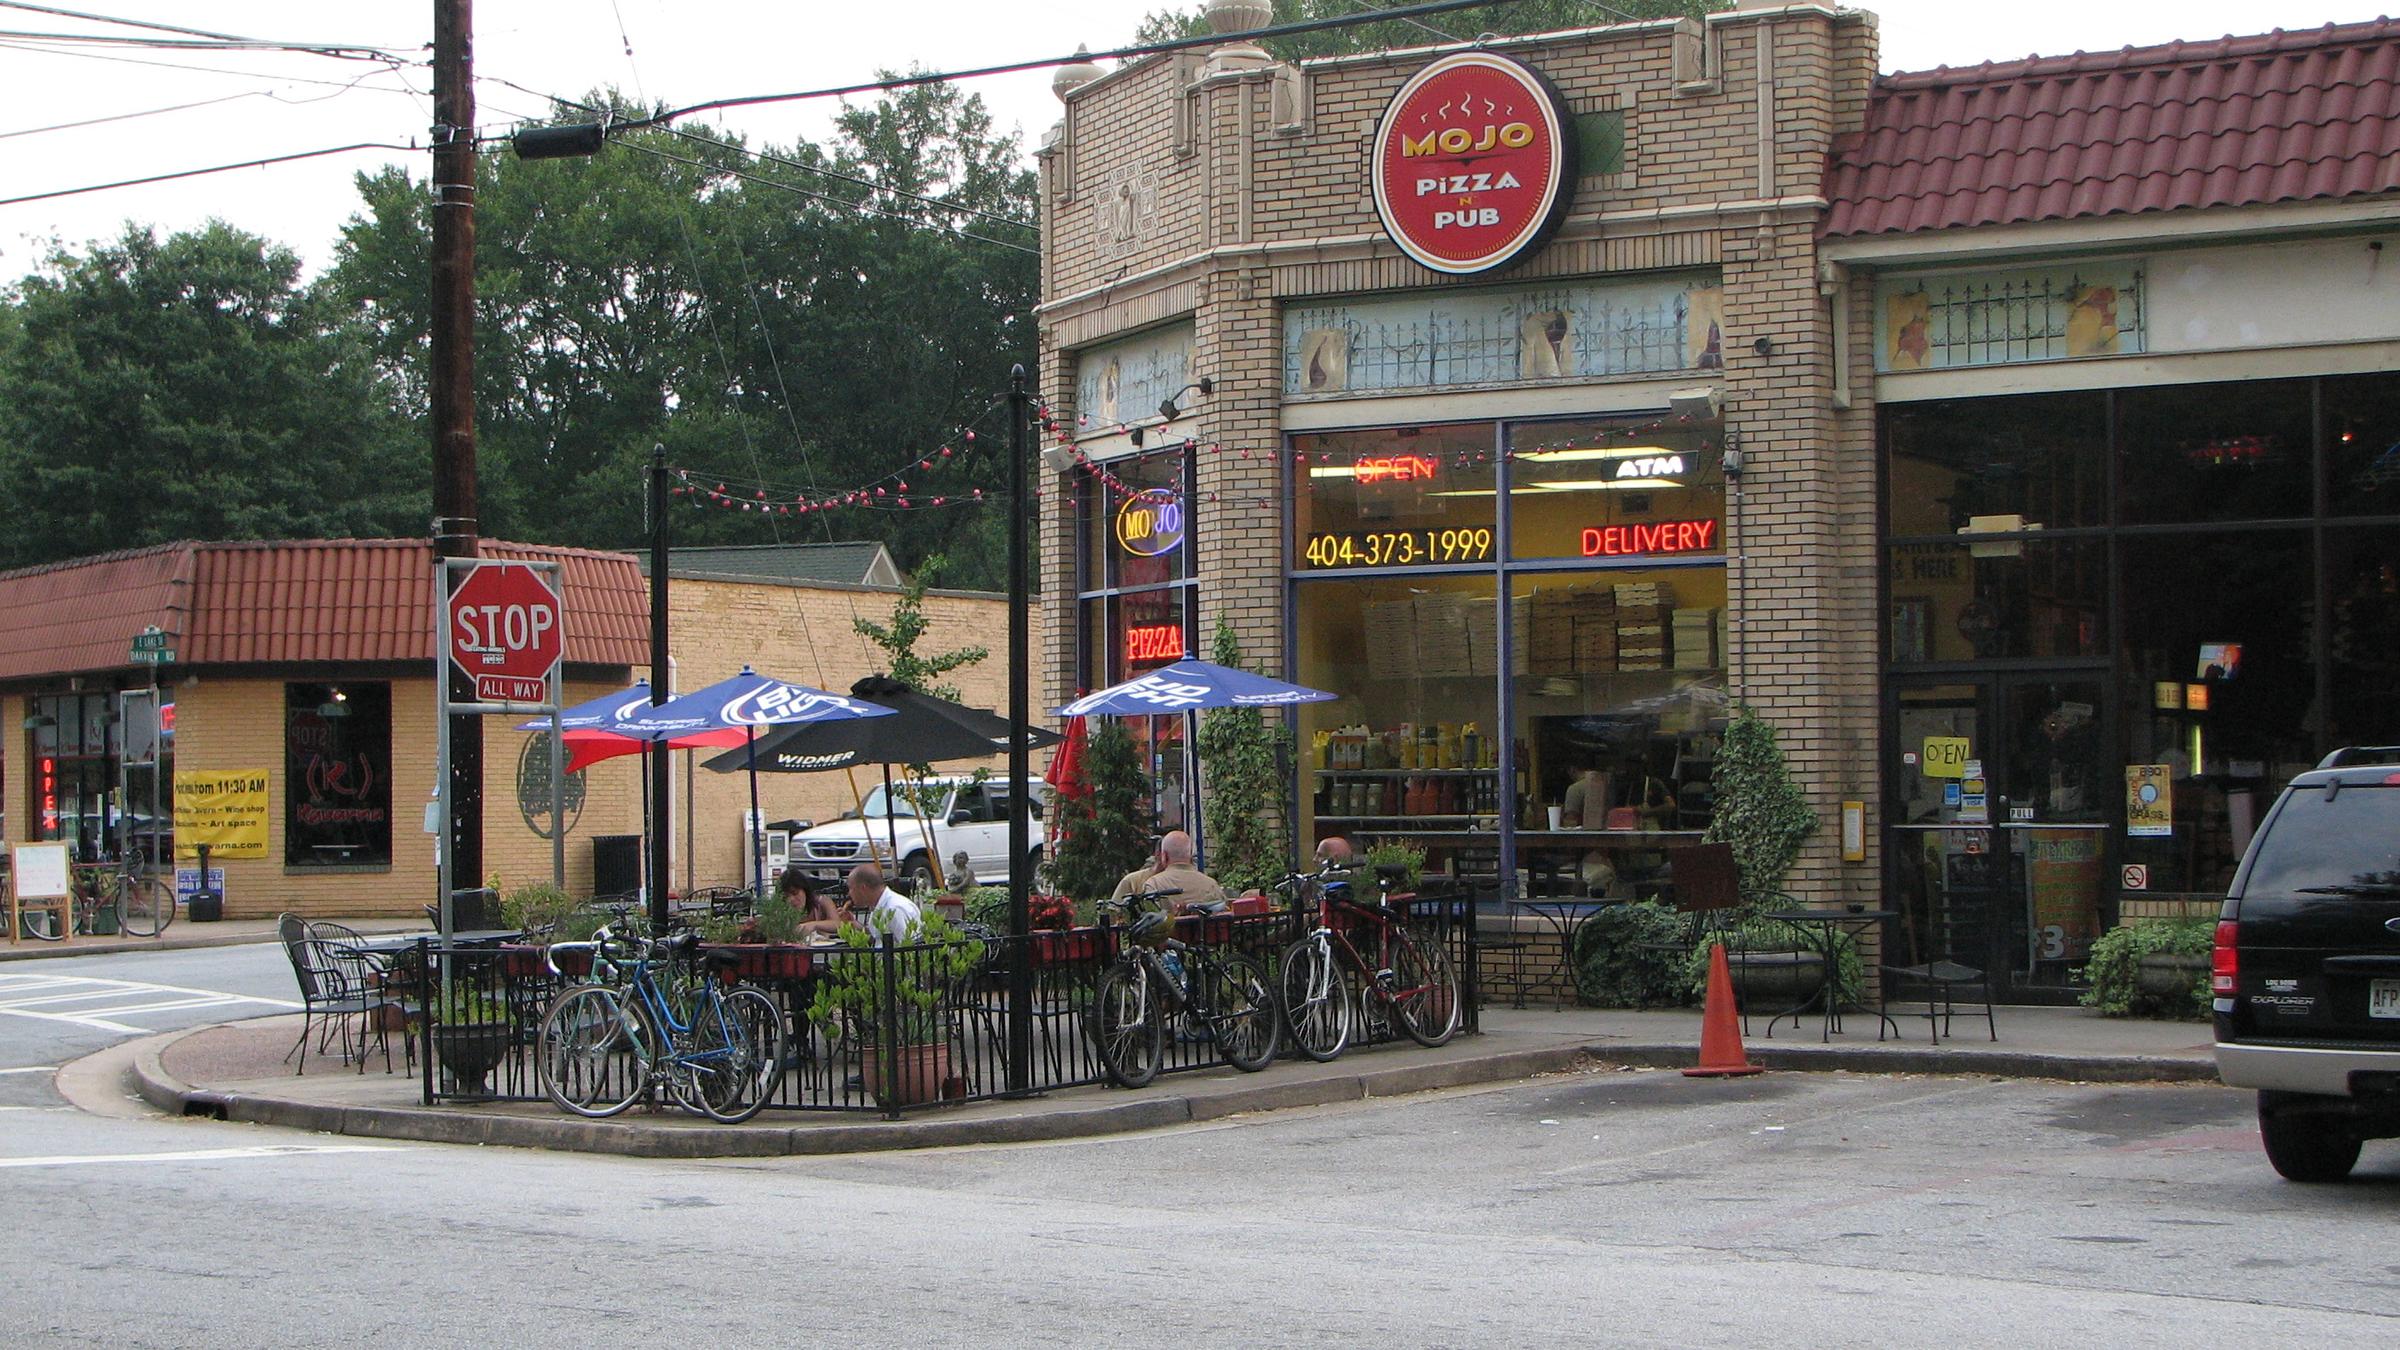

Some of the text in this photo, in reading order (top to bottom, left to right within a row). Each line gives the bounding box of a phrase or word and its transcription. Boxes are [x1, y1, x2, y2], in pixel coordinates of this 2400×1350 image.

[1402, 122, 1535, 157] MOJO
[1435, 208, 1500, 229] PUB
[1355, 455, 1434, 483] OPEN
[1616, 456, 1684, 478] ATM
[1306, 529, 1490, 566] 404-373-1999
[1582, 520, 1713, 556] DELIVERY
[458, 604, 553, 652] STOP
[1128, 626, 1184, 660] PIZZA
[483, 681, 539, 699] ALL WAY
[777, 750, 856, 765] WIDMER
[218, 779, 246, 794] 11:30
[249, 779, 265, 793] AM
[225, 805, 244, 813] Wine
[247, 804, 265, 814] shop
[2011, 810, 2032, 818] PULL
[210, 820, 225, 828] Art
[228, 820, 257, 828] space
[2250, 995, 2315, 1005] EXPLORER
